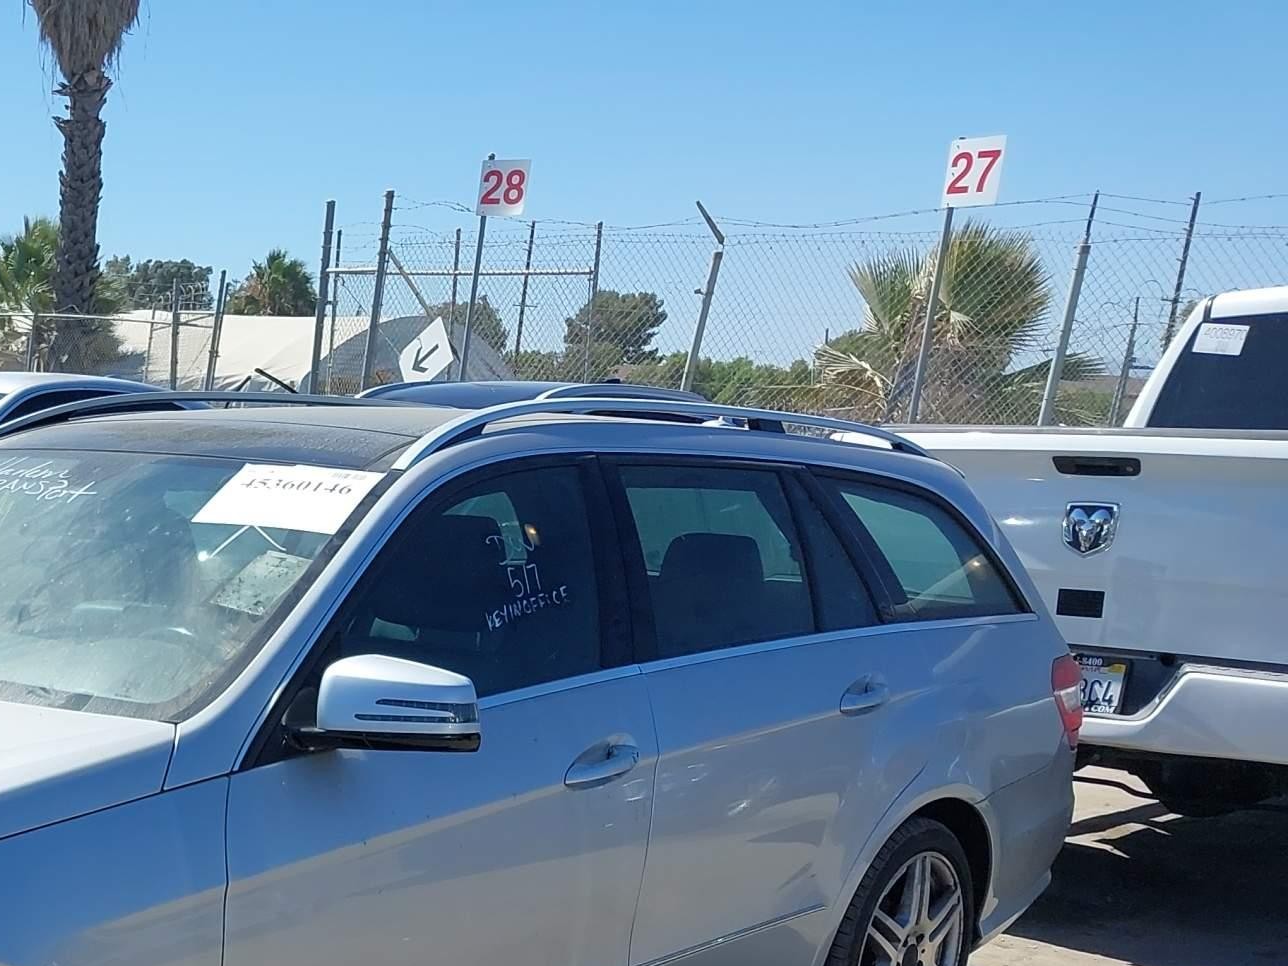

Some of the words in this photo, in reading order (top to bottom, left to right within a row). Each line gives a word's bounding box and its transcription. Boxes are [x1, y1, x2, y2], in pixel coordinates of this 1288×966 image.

[479, 169, 526, 205] 28
[946, 149, 1002, 195] 27
[240, 477, 353, 496] 45360146
